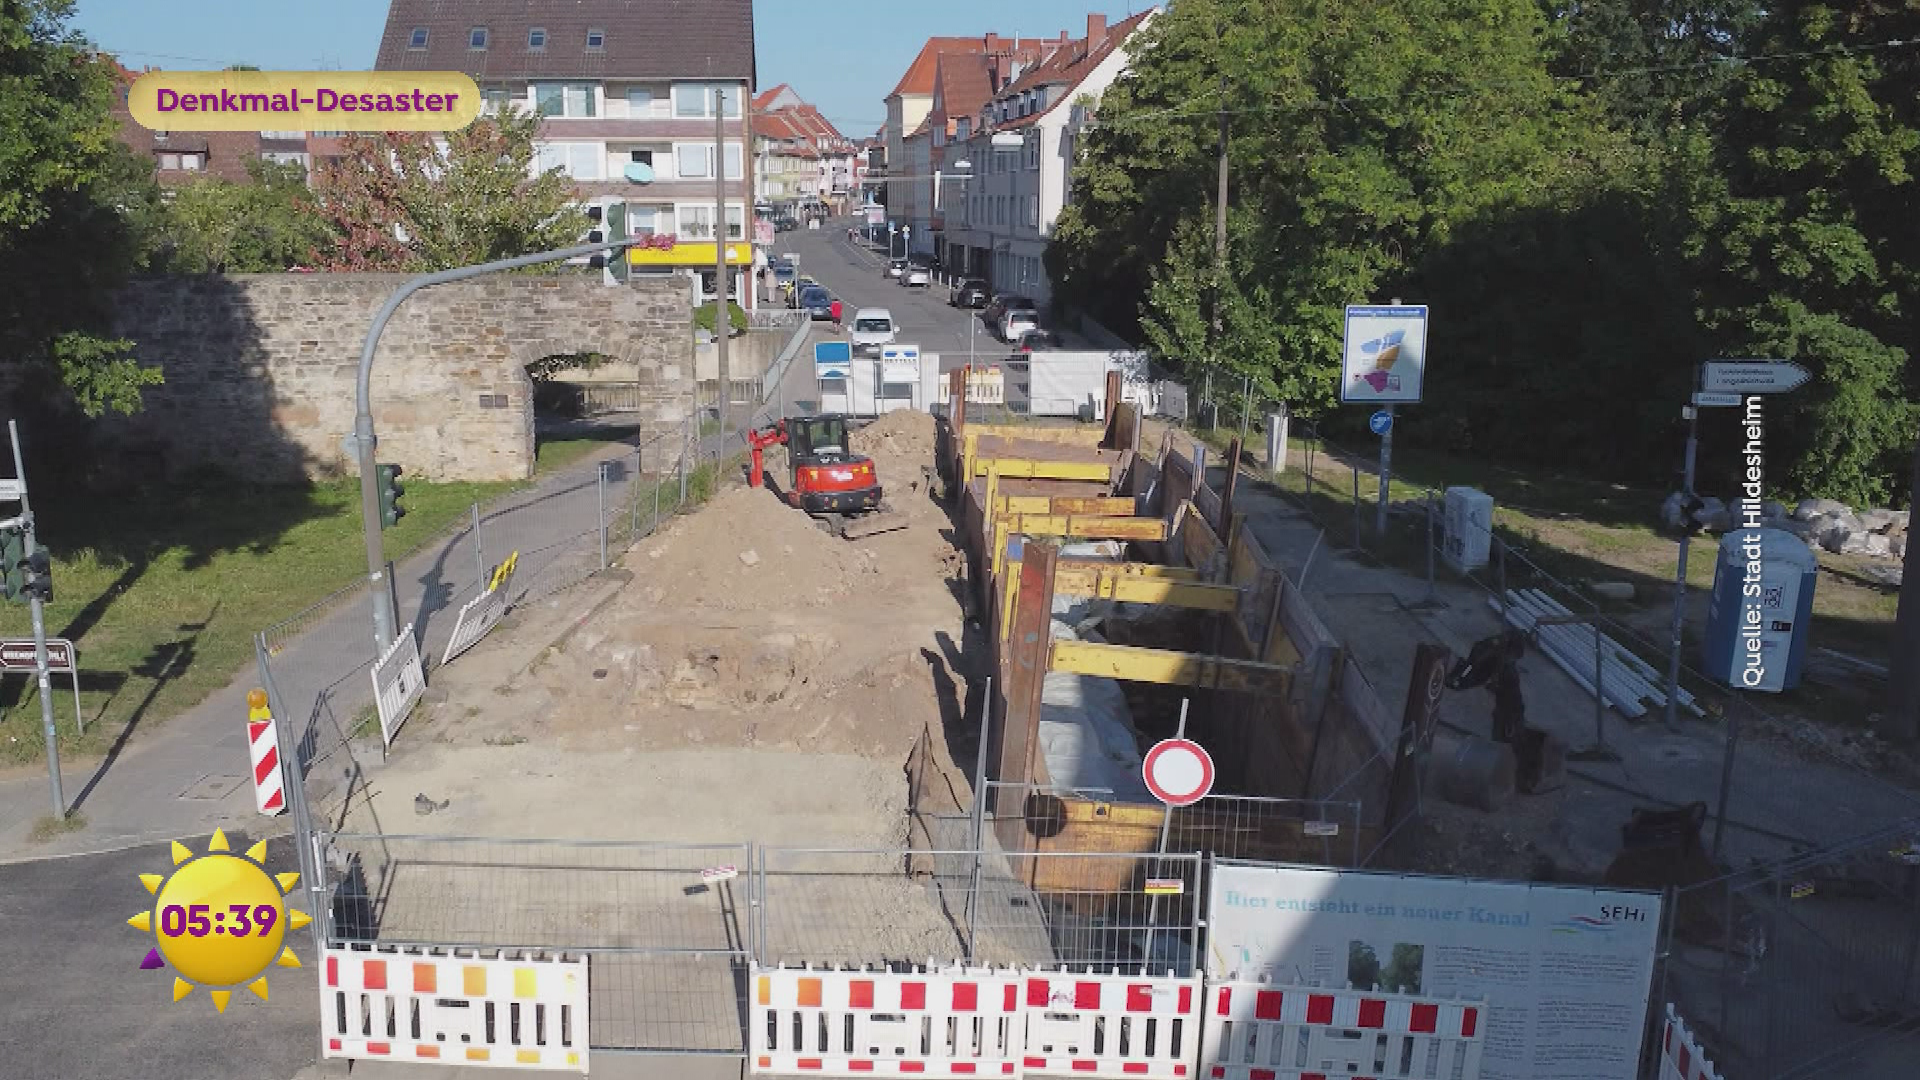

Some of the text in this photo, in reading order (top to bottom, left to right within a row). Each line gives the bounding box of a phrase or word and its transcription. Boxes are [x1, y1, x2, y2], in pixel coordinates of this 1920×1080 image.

[1224, 890, 1530, 926] Hier entsteht ein neuer Kanal
